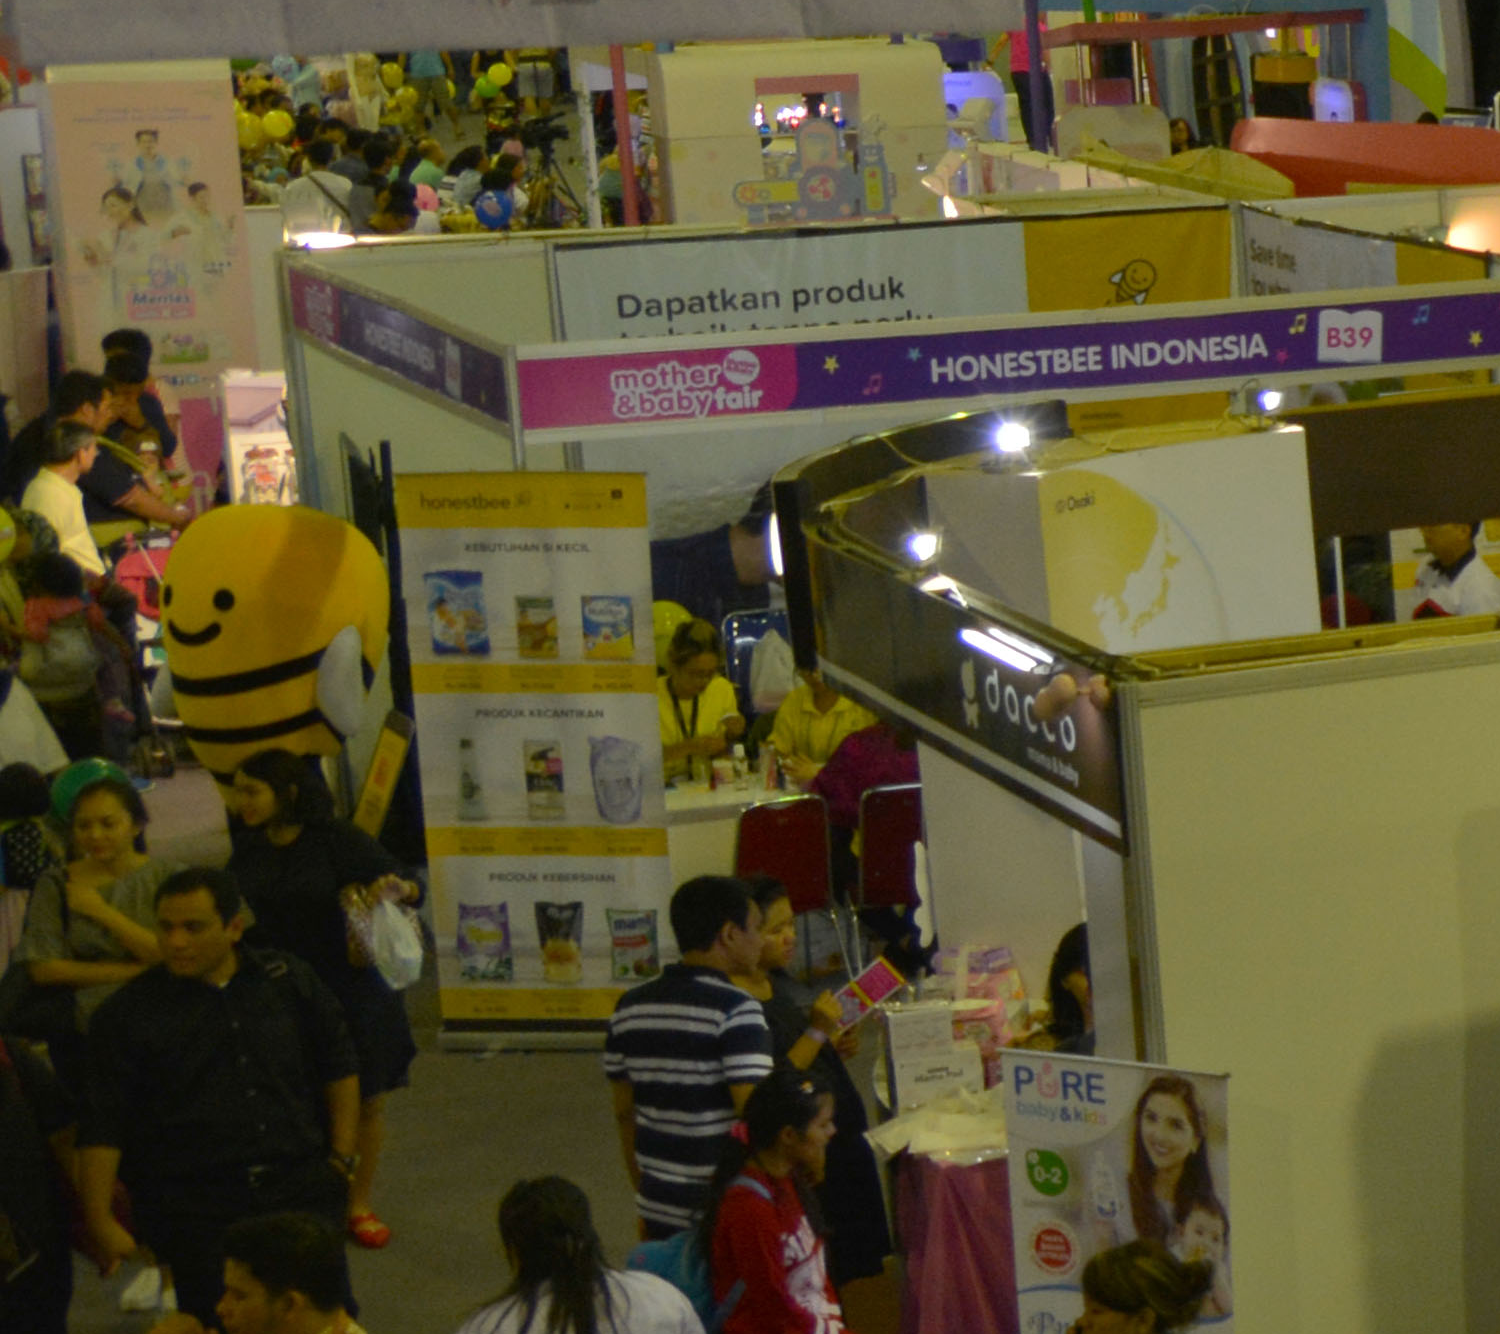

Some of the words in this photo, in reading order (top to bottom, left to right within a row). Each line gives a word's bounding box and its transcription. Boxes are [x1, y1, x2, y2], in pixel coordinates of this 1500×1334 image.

[616, 287, 782, 321] Dapatkan
[792, 275, 906, 313] produk
[932, 341, 1102, 385] HONESTBEE
[1111, 333, 1268, 369] INDONESIA
[1326, 325, 1374, 349] B39
[611, 361, 721, 392] mother
[613, 387, 713, 418] &baby
[714, 385, 763, 410] fair
[418, 490, 512, 511] honestbee
[555, 542, 591, 553] KECIL
[1014, 1060, 1106, 1104] PURE
[1033, 1167, 1063, 1185] 0-2
